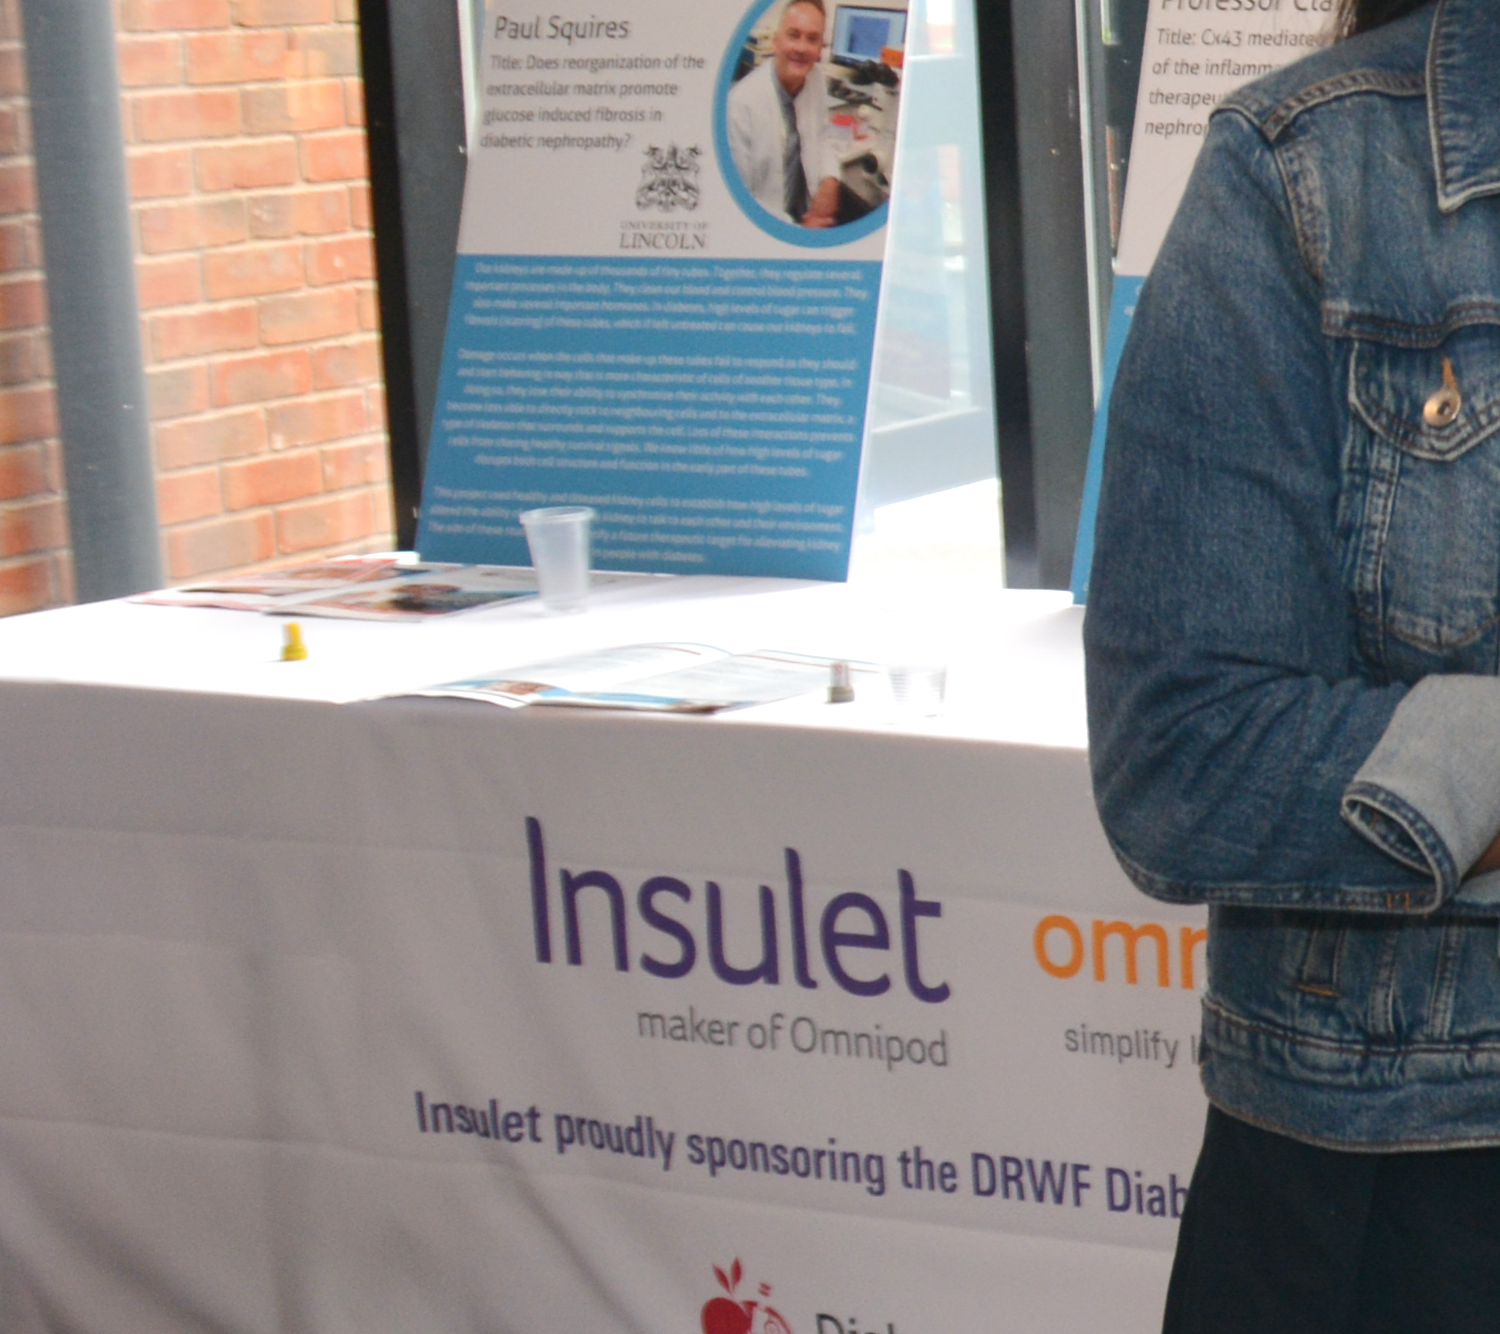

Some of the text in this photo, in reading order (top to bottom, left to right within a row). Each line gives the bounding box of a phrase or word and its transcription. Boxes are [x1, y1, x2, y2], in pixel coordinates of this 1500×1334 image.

[494, 15, 629, 44] Paul Squires
[1157, 27, 1242, 47] Title: Cx43
[619, 232, 705, 250] LINCOLN
[524, 816, 951, 1003] Insulet
[637, 1005, 948, 1070] maker of Omnipod
[1064, 1023, 1179, 1069] simplify
[414, 1090, 1091, 1207] Insulet proudly sponsoring the DRWF
